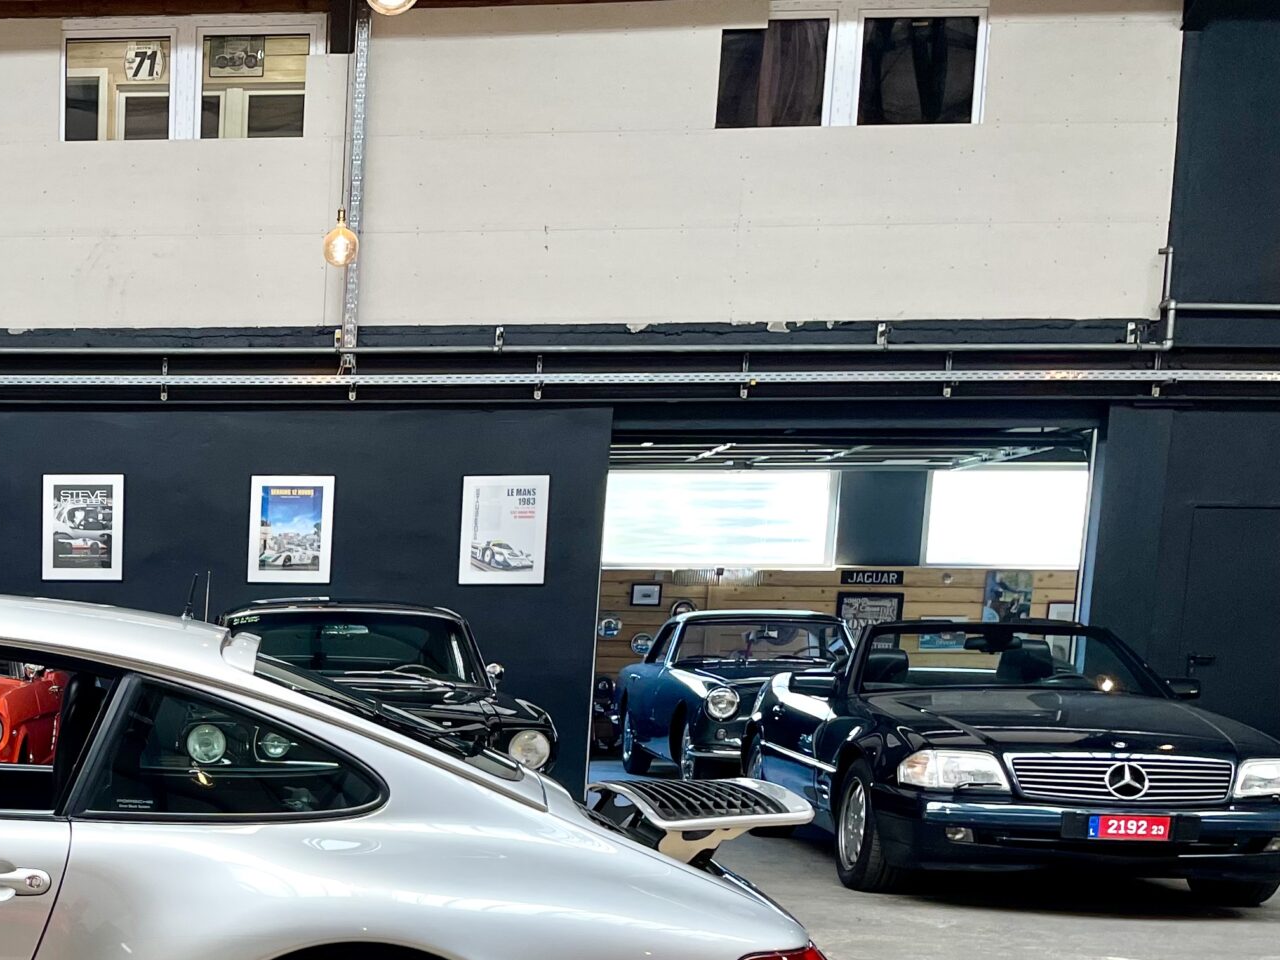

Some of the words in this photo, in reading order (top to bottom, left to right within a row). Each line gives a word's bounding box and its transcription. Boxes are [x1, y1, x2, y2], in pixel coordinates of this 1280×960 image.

[132, 50, 158, 78] 71
[60, 489, 108, 500] STEVE
[506, 488, 515, 497] LE
[515, 487, 537, 497] MANS
[518, 497, 536, 506] 1983
[847, 572, 898, 584] JAGUAR
[1089, 828, 1095, 836] L
[1107, 819, 1148, 835] 2192
[1150, 825, 1165, 835] 23
